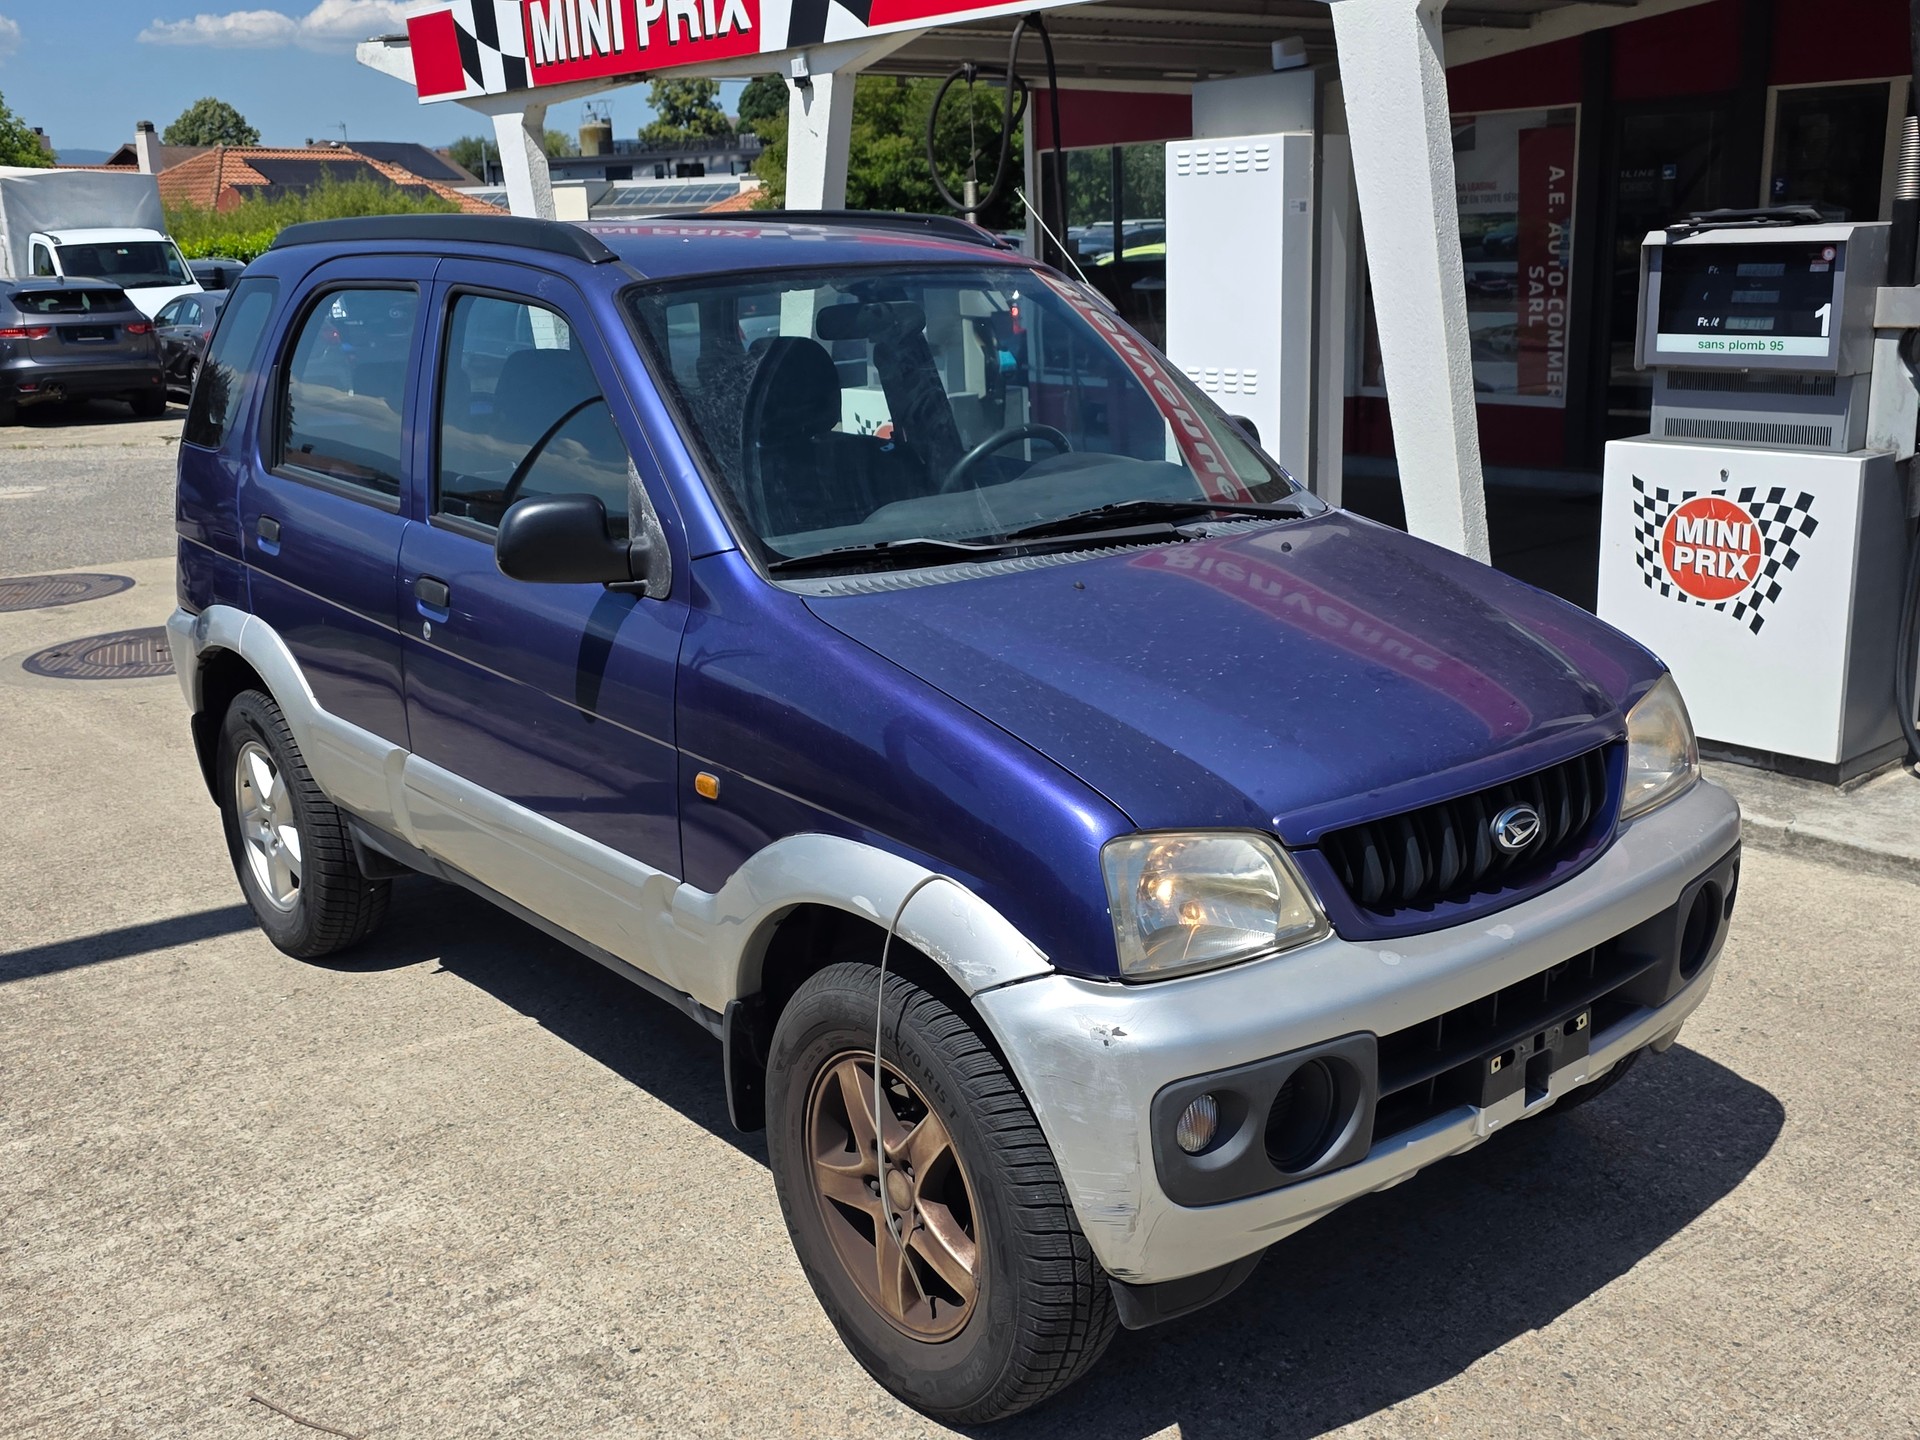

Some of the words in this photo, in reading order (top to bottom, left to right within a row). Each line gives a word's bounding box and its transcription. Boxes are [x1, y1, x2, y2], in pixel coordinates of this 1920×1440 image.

[529, 0, 625, 67] MINI
[636, 0, 753, 51] PRIX
[1527, 265, 1545, 327] SARL
[1815, 302, 1832, 336] 1
[1697, 341, 1725, 350] sans
[1728, 339, 1766, 352] plomb
[1769, 340, 1784, 351] 95
[1674, 515, 1754, 551] MINI
[1673, 545, 1752, 582] PRIX
